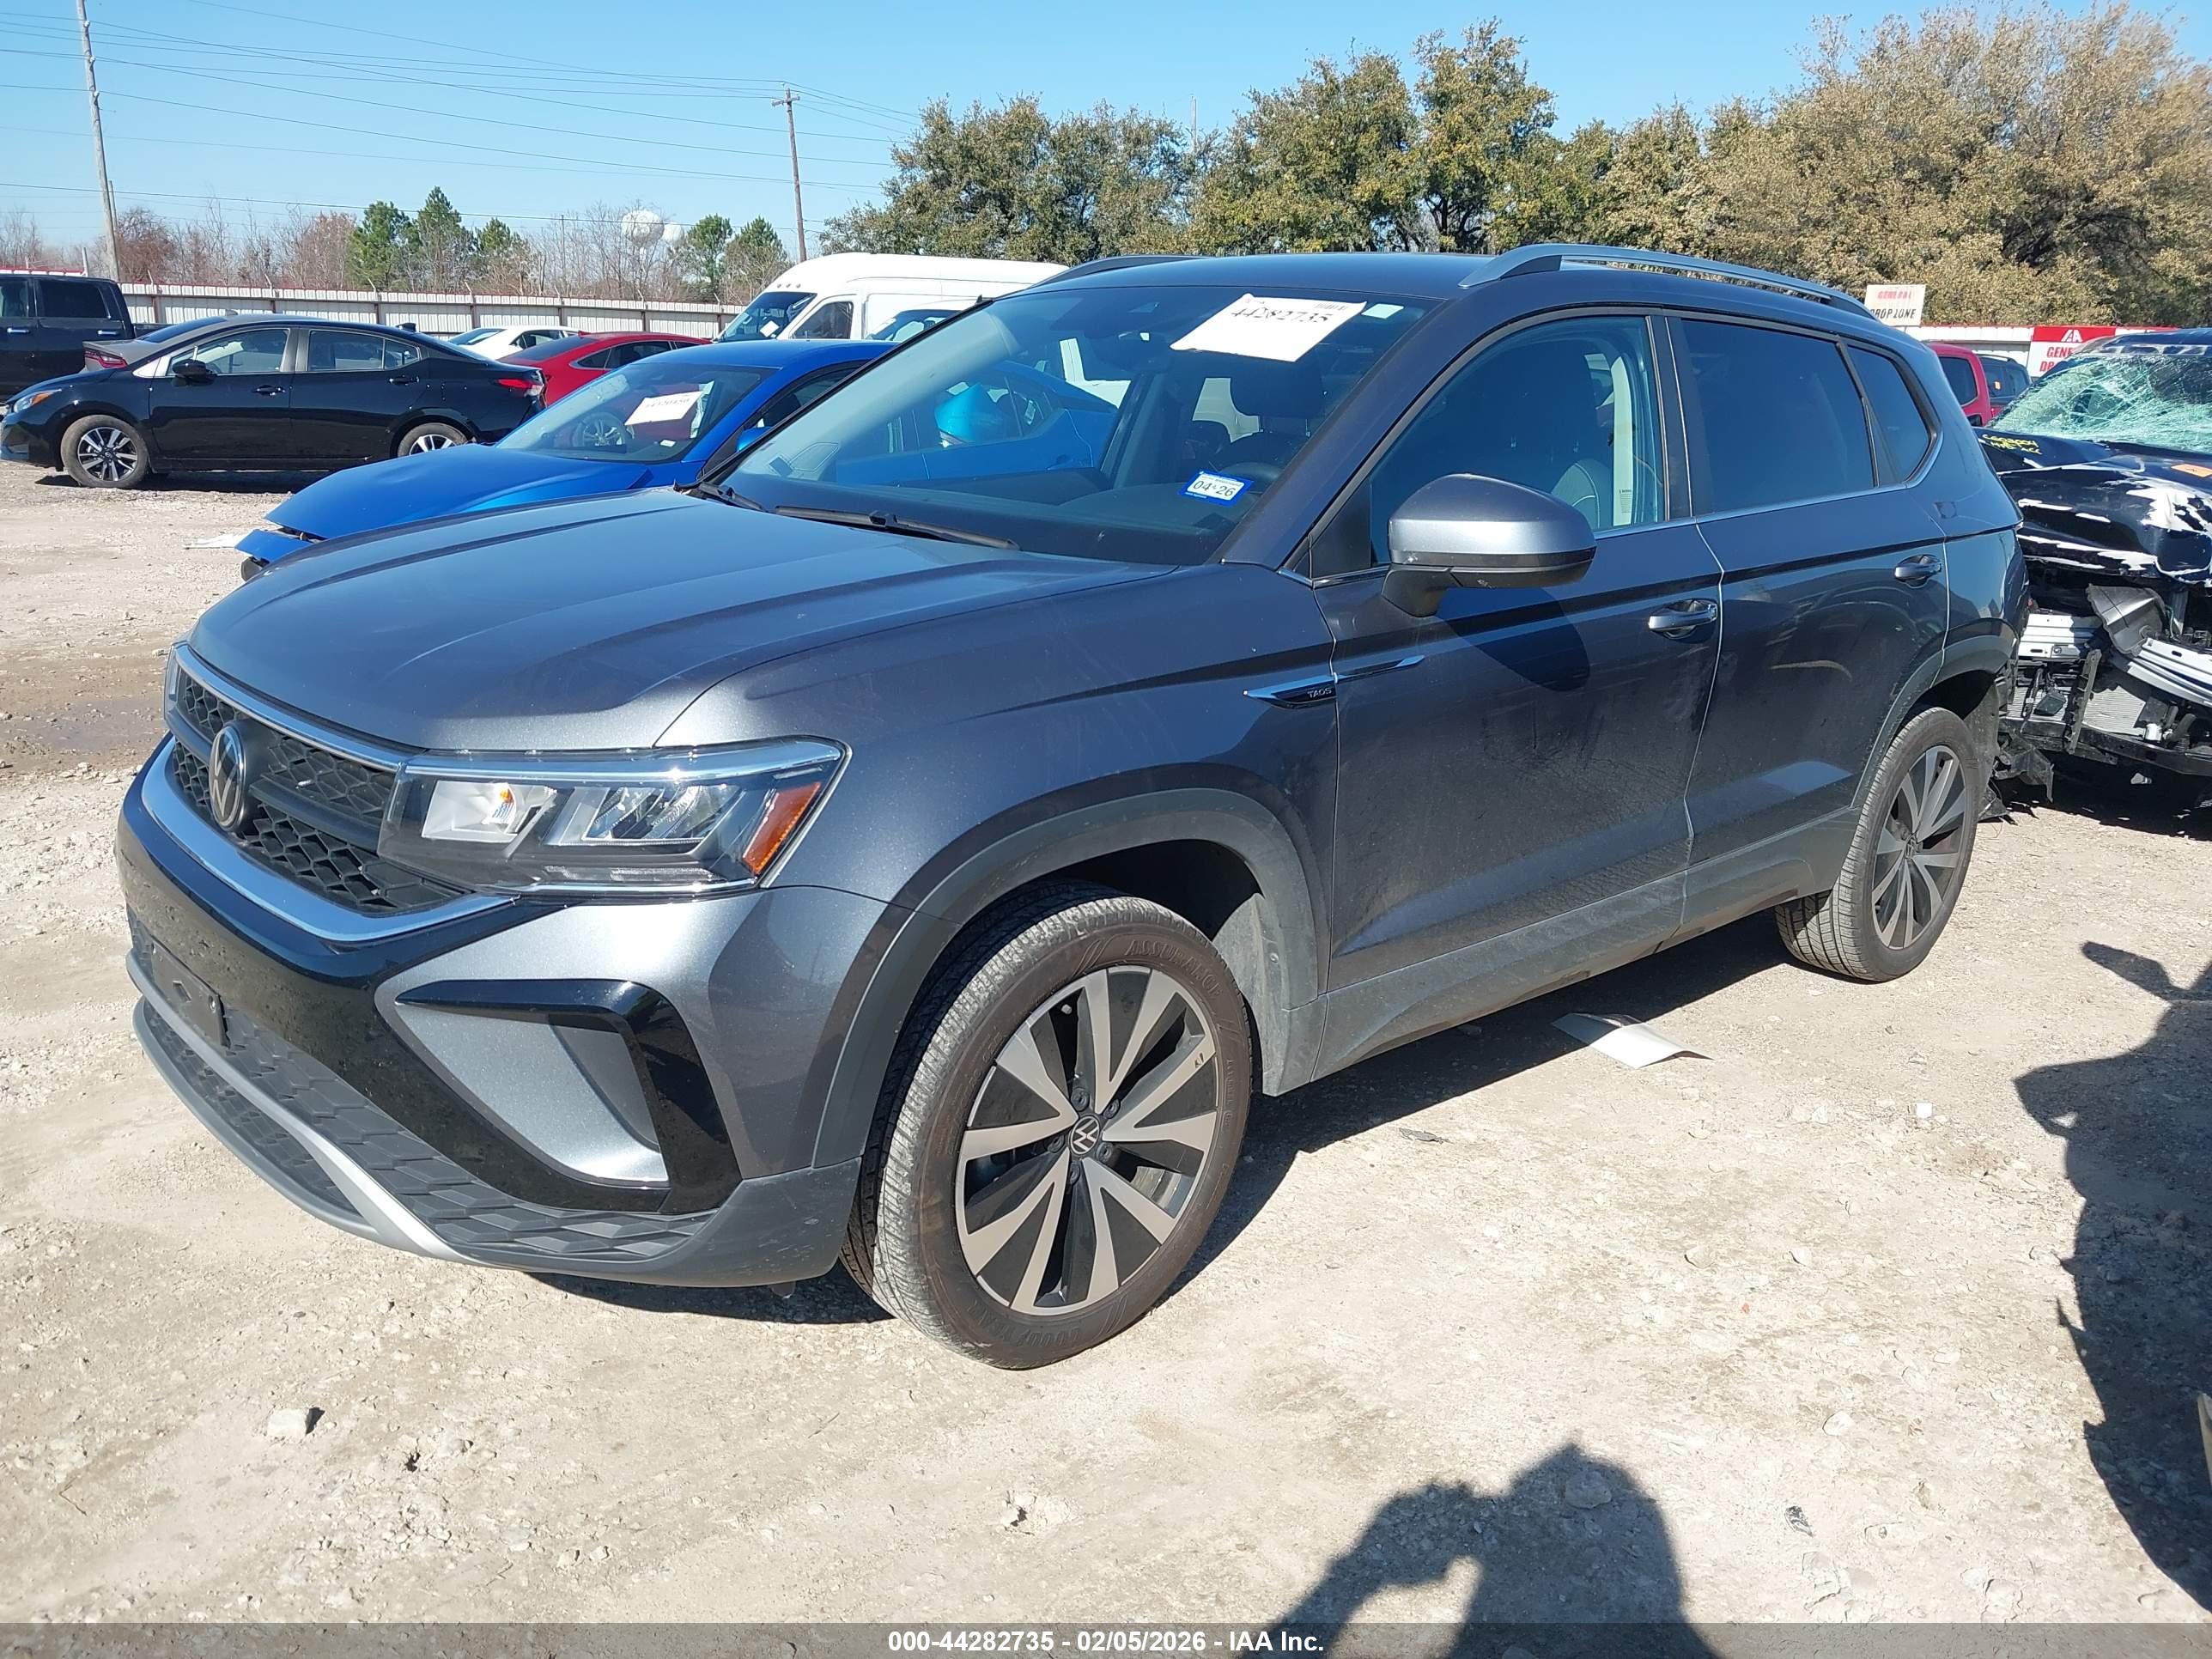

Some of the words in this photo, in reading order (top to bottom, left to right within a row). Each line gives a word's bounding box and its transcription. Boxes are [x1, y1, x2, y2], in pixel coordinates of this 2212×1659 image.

[1193, 480, 1212, 492] 04
[1215, 485, 1237, 497] 26
[1307, 687, 1333, 698] TAOS
